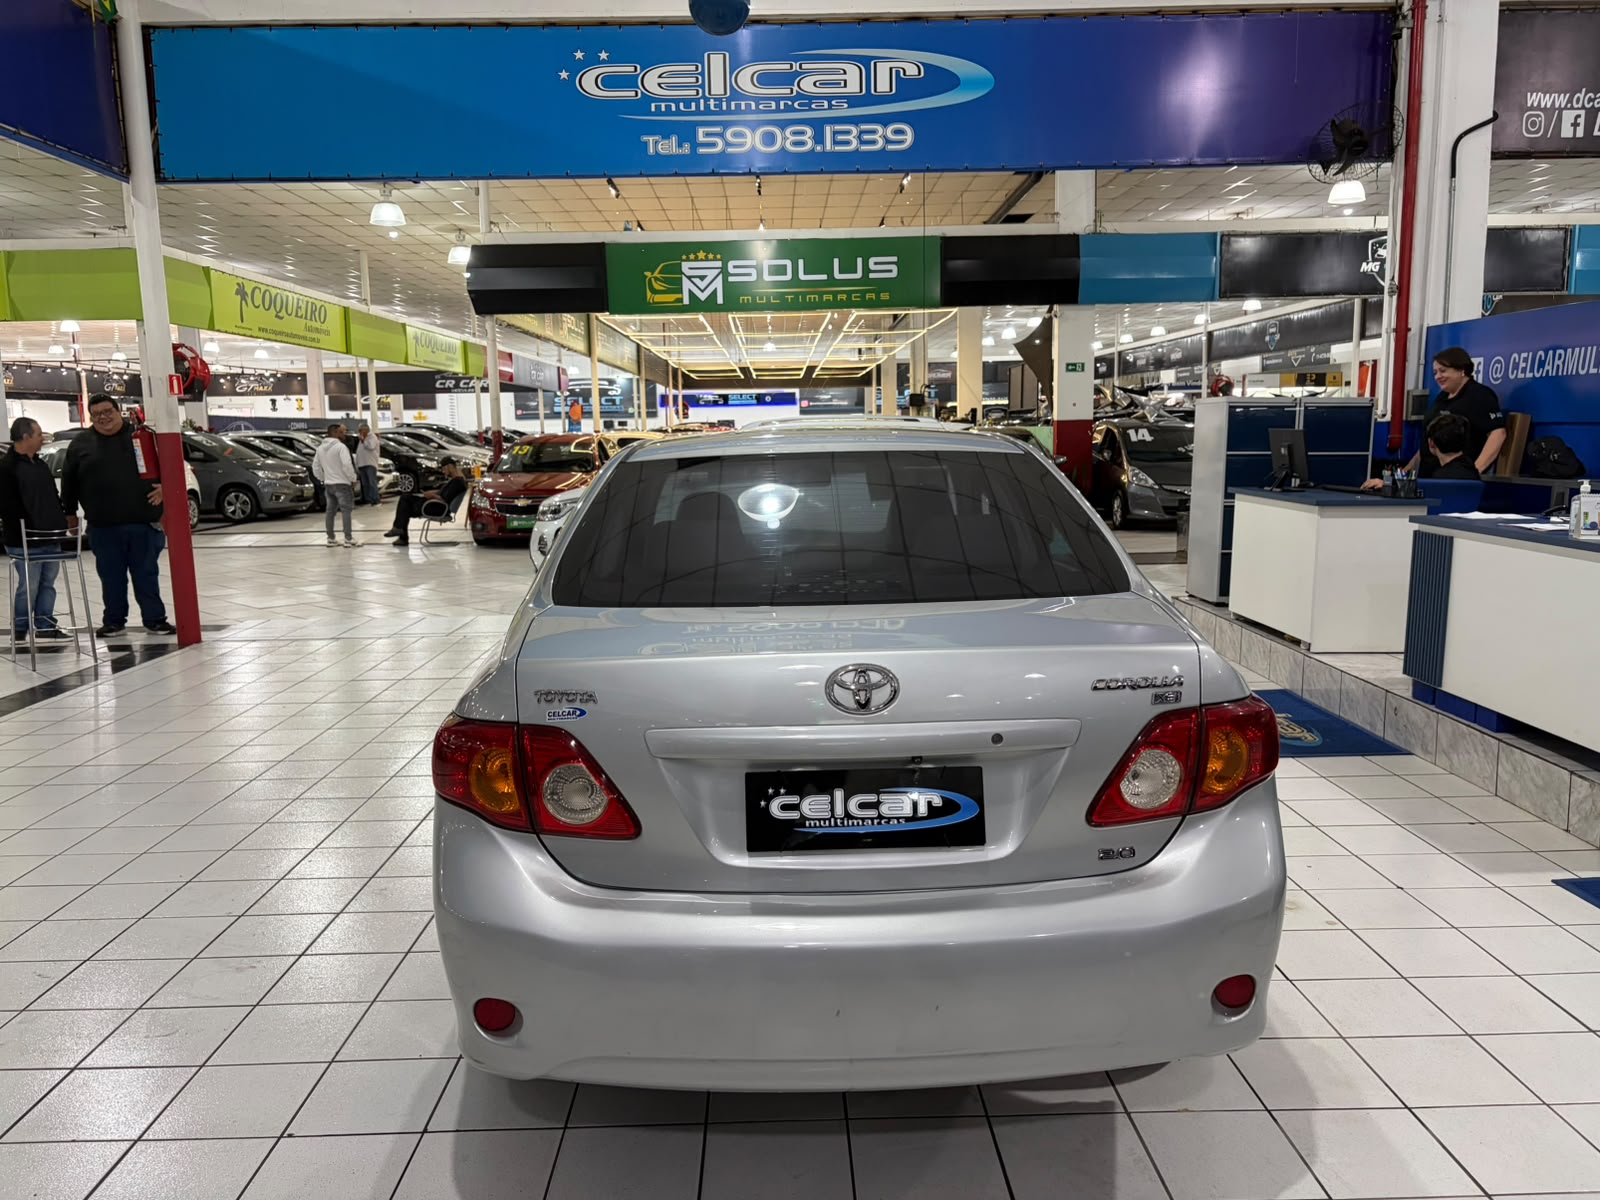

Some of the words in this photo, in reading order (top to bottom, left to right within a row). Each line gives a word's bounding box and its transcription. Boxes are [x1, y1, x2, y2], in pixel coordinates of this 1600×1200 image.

[575, 51, 925, 99] celcar
[650, 98, 849, 112] multimarcas
[641, 135, 691, 155] Tel.:
[696, 122, 914, 155] 5908.1339
[727, 256, 898, 282] SOLUS
[1360, 261, 1381, 273] MG
[250, 285, 328, 325] COQUEIRO
[739, 292, 890, 304] MULTIMARCAS
[1508, 345, 1600, 380] CELCARMUL
[435, 379, 456, 388] CR
[1126, 428, 1154, 443] 14
[512, 445, 530, 455] 13
[1091, 674, 1185, 691] COROLLA
[534, 689, 599, 705] TOYOTA
[547, 710, 577, 718] CELCAR
[769, 788, 943, 820] celcar
[805, 817, 907, 828] multimarcas
[1097, 846, 1136, 861] 2.0
